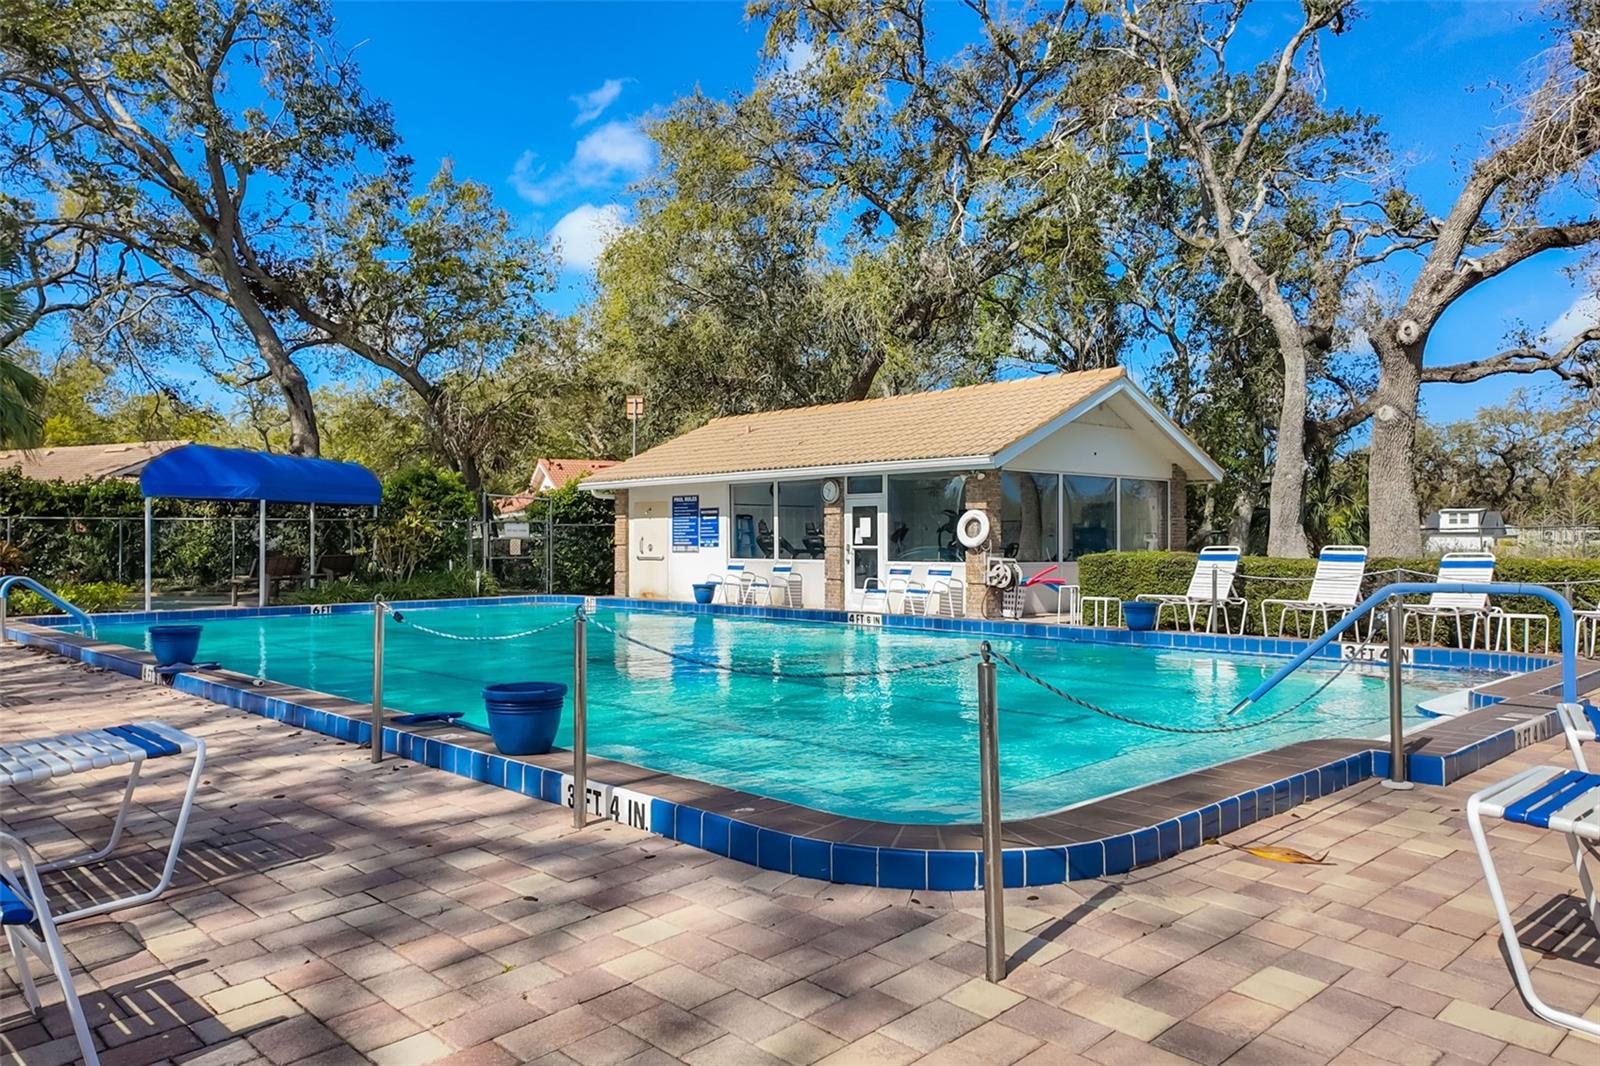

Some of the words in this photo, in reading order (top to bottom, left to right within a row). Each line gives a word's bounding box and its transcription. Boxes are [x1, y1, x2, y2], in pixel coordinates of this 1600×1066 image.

[312, 606, 320, 615] 6
[849, 614, 855, 623] 4
[856, 614, 864, 624] FT
[866, 616, 871, 625] 6
[873, 616, 880, 625] IN
[1344, 645, 1356, 660] 3
[1360, 648, 1375, 661] FT
[1380, 648, 1390, 660] 4
[568, 784, 575, 809] 3
[610, 795, 620, 823] 4
[628, 799, 649, 832] IN.
